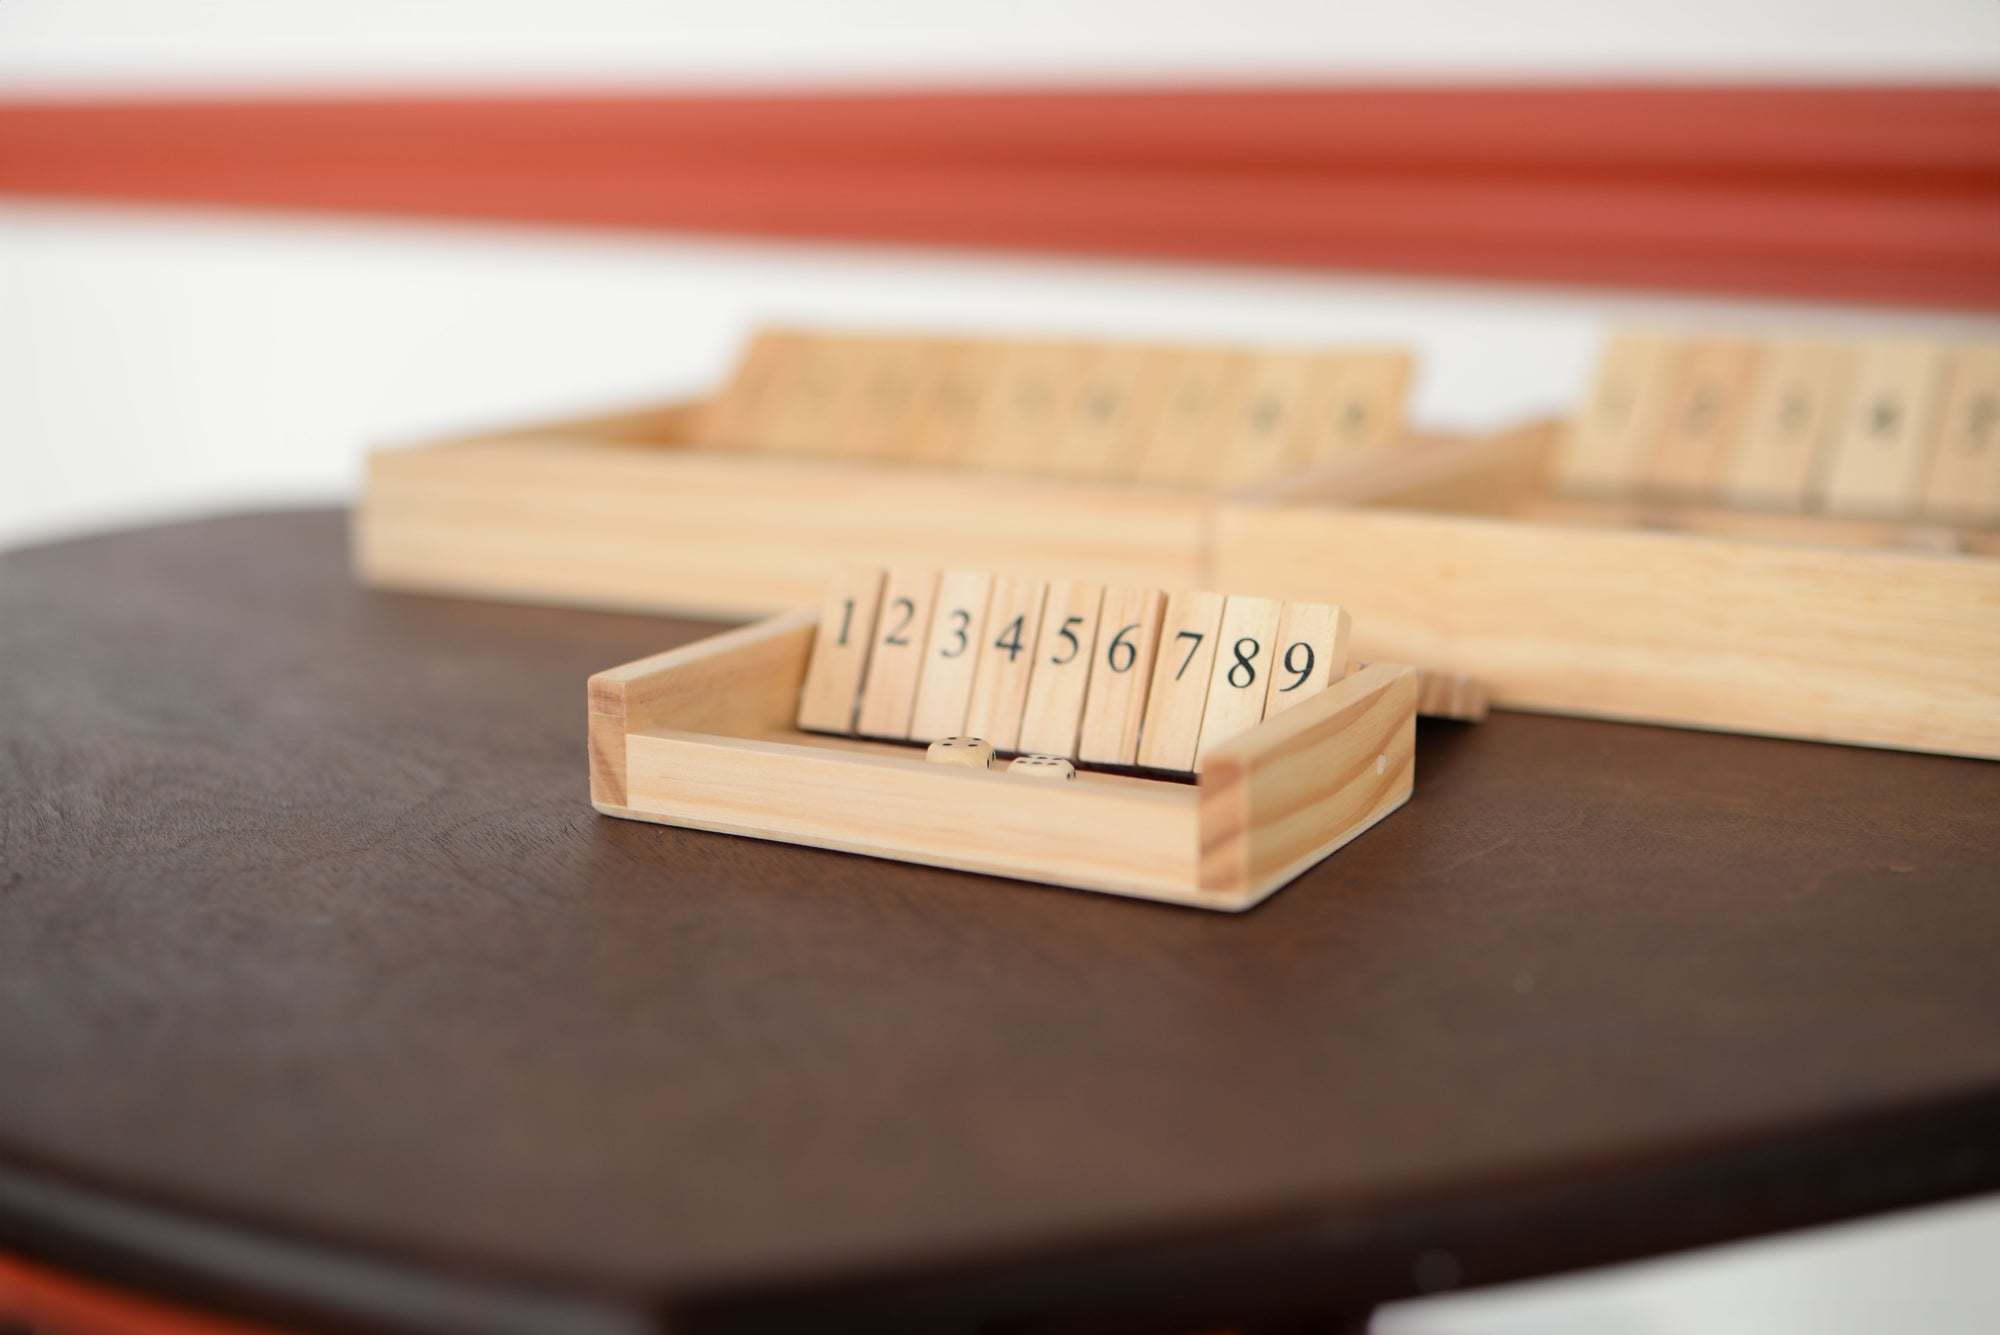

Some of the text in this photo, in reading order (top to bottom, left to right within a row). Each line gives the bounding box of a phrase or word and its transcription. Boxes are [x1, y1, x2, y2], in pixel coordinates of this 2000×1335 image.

[837, 597, 1315, 693] 1 2 3 4 5 6 7 8 9
